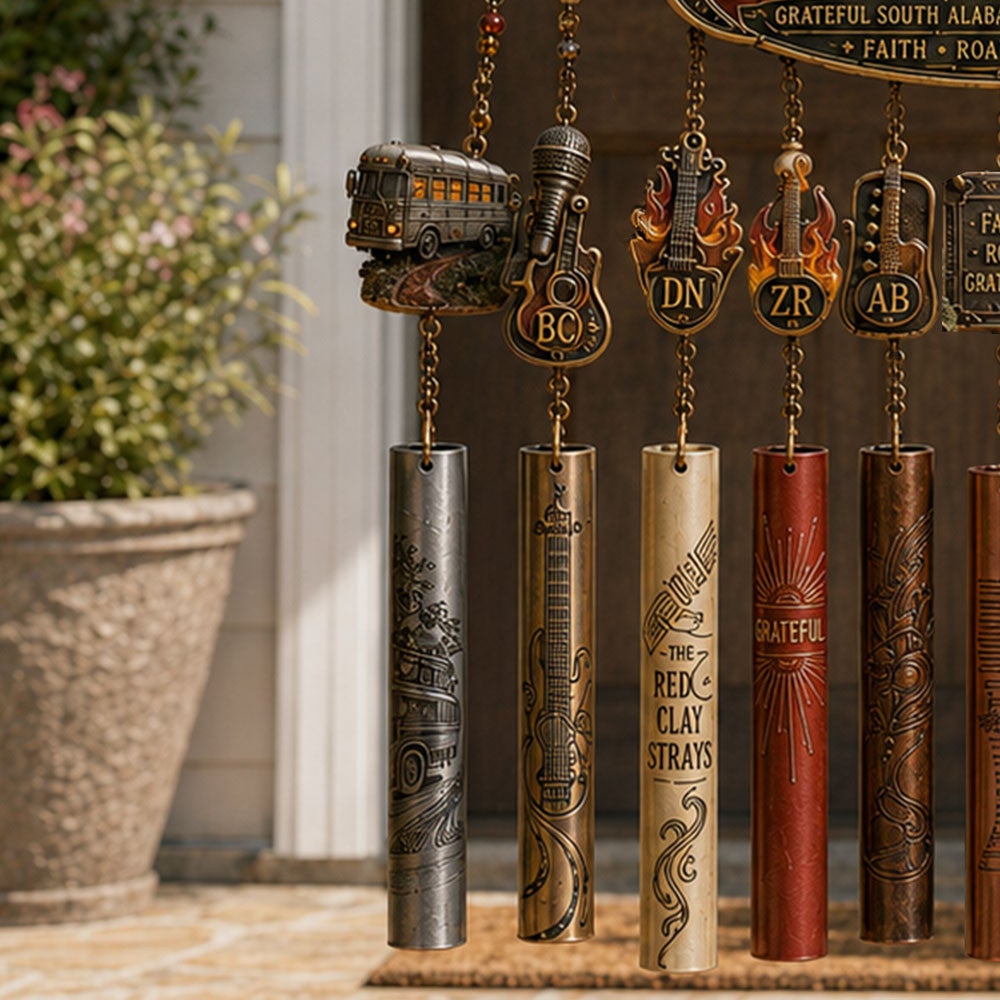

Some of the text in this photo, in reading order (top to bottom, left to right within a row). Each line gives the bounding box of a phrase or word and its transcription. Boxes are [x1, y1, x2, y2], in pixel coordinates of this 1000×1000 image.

[775, 5, 871, 25] GRATEFUL
[877, 5, 939, 25] SOUTH
[863, 39, 927, 60] FAITH
[660, 276, 706, 309] DN
[770, 284, 813, 317] ZR
[866, 282, 910, 314] AB
[537, 311, 576, 344] BC
[756, 618, 826, 643] GRATEFUL
[669, 645, 694, 661] THE
[654, 671, 691, 698] RED
[656, 705, 702, 734] CLAY
[647, 741, 712, 770] STRAYS
